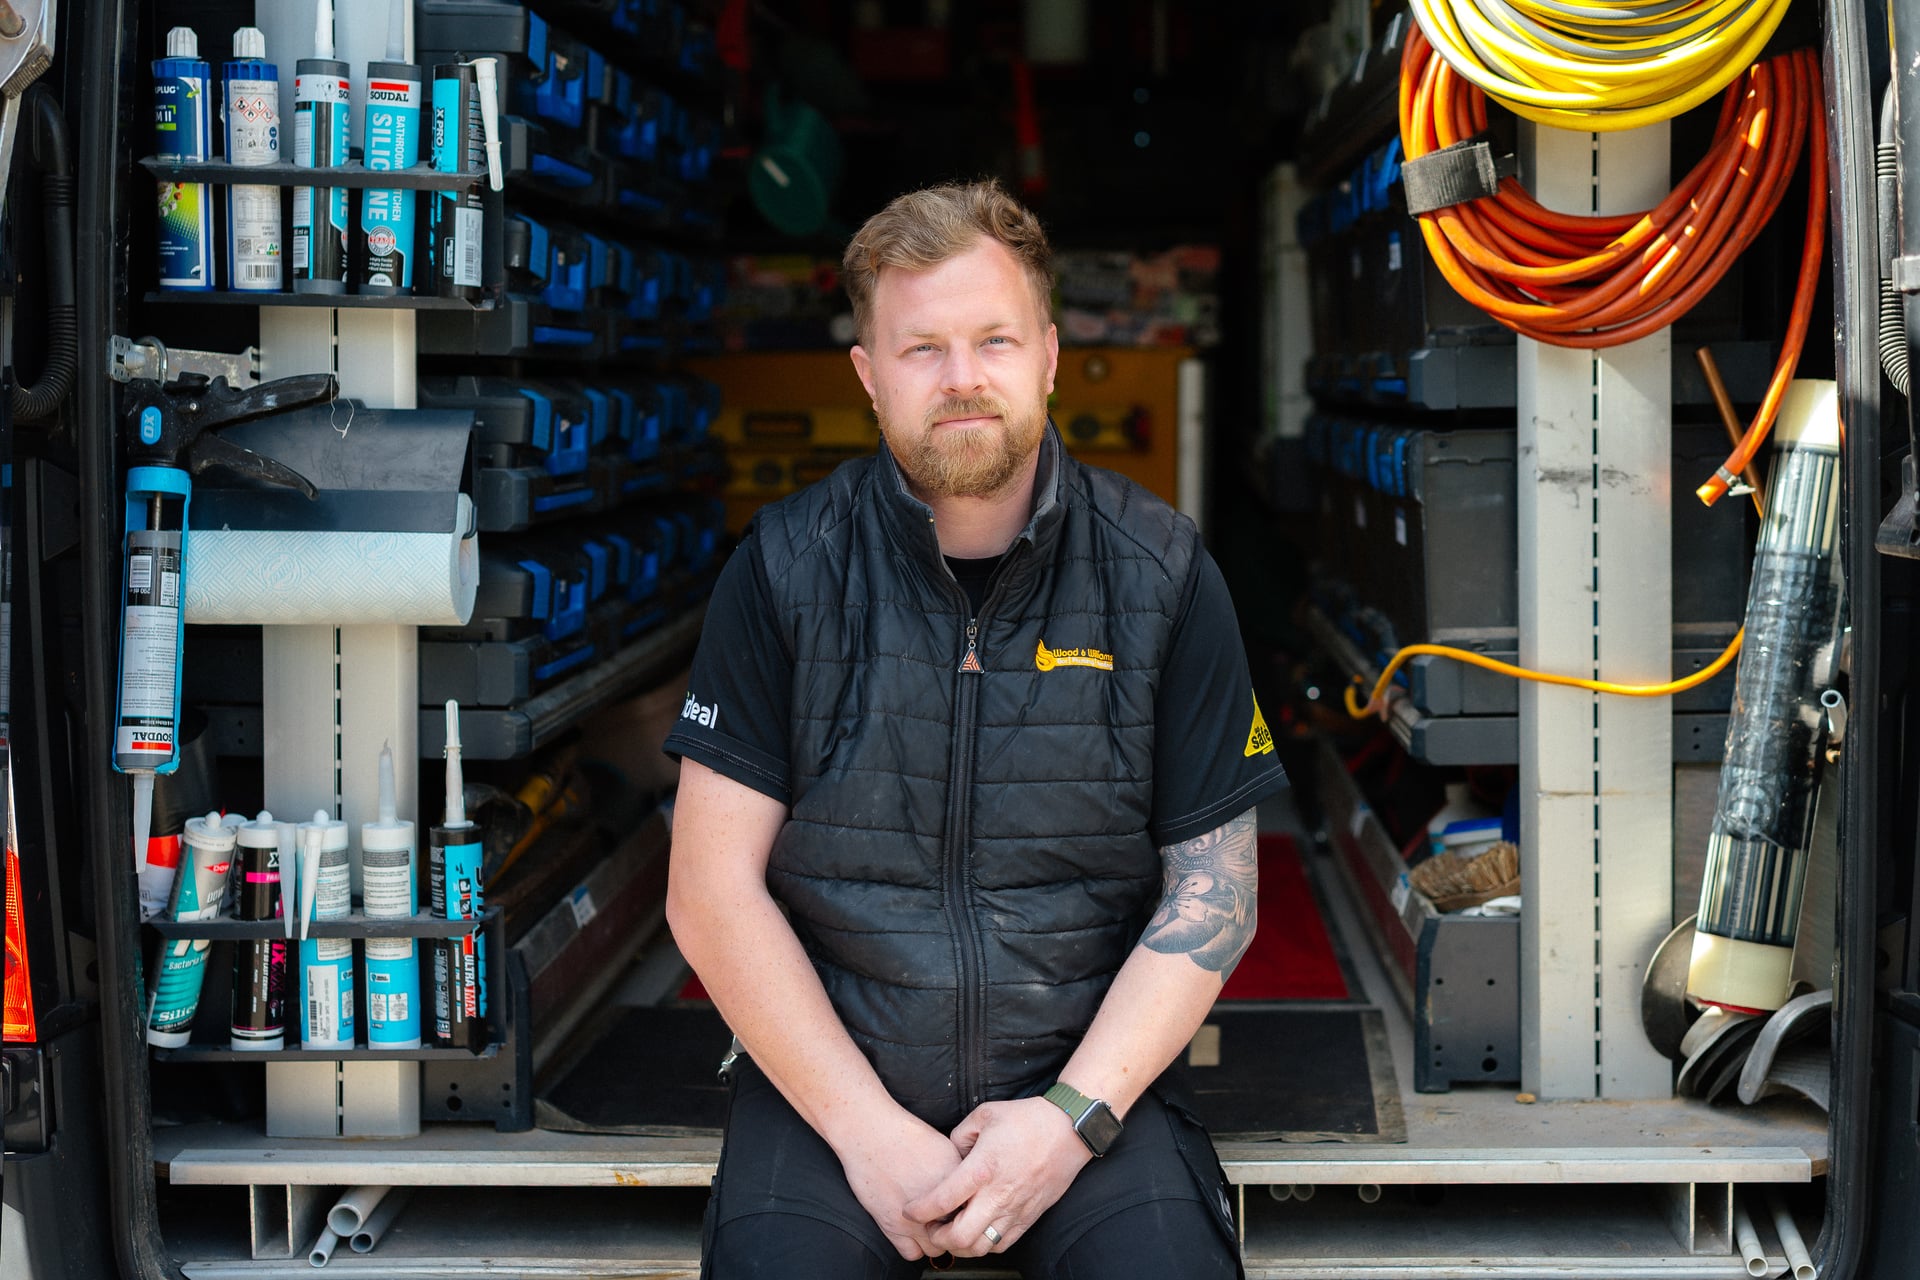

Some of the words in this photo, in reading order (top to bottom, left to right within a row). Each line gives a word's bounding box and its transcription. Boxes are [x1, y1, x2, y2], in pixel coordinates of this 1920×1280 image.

[370, 91, 409, 102] SOUDAL
[436, 108, 444, 118] X
[394, 115, 406, 170] BATHROOM
[436, 120, 444, 147] PRO
[392, 188, 403, 221] TCHEN
[143, 413, 155, 439] OX
[1053, 647, 1079, 658] Wood
[132, 731, 172, 742] SOUDAL
[464, 954, 476, 987] ULTRA
[158, 1002, 198, 1022] Silic
